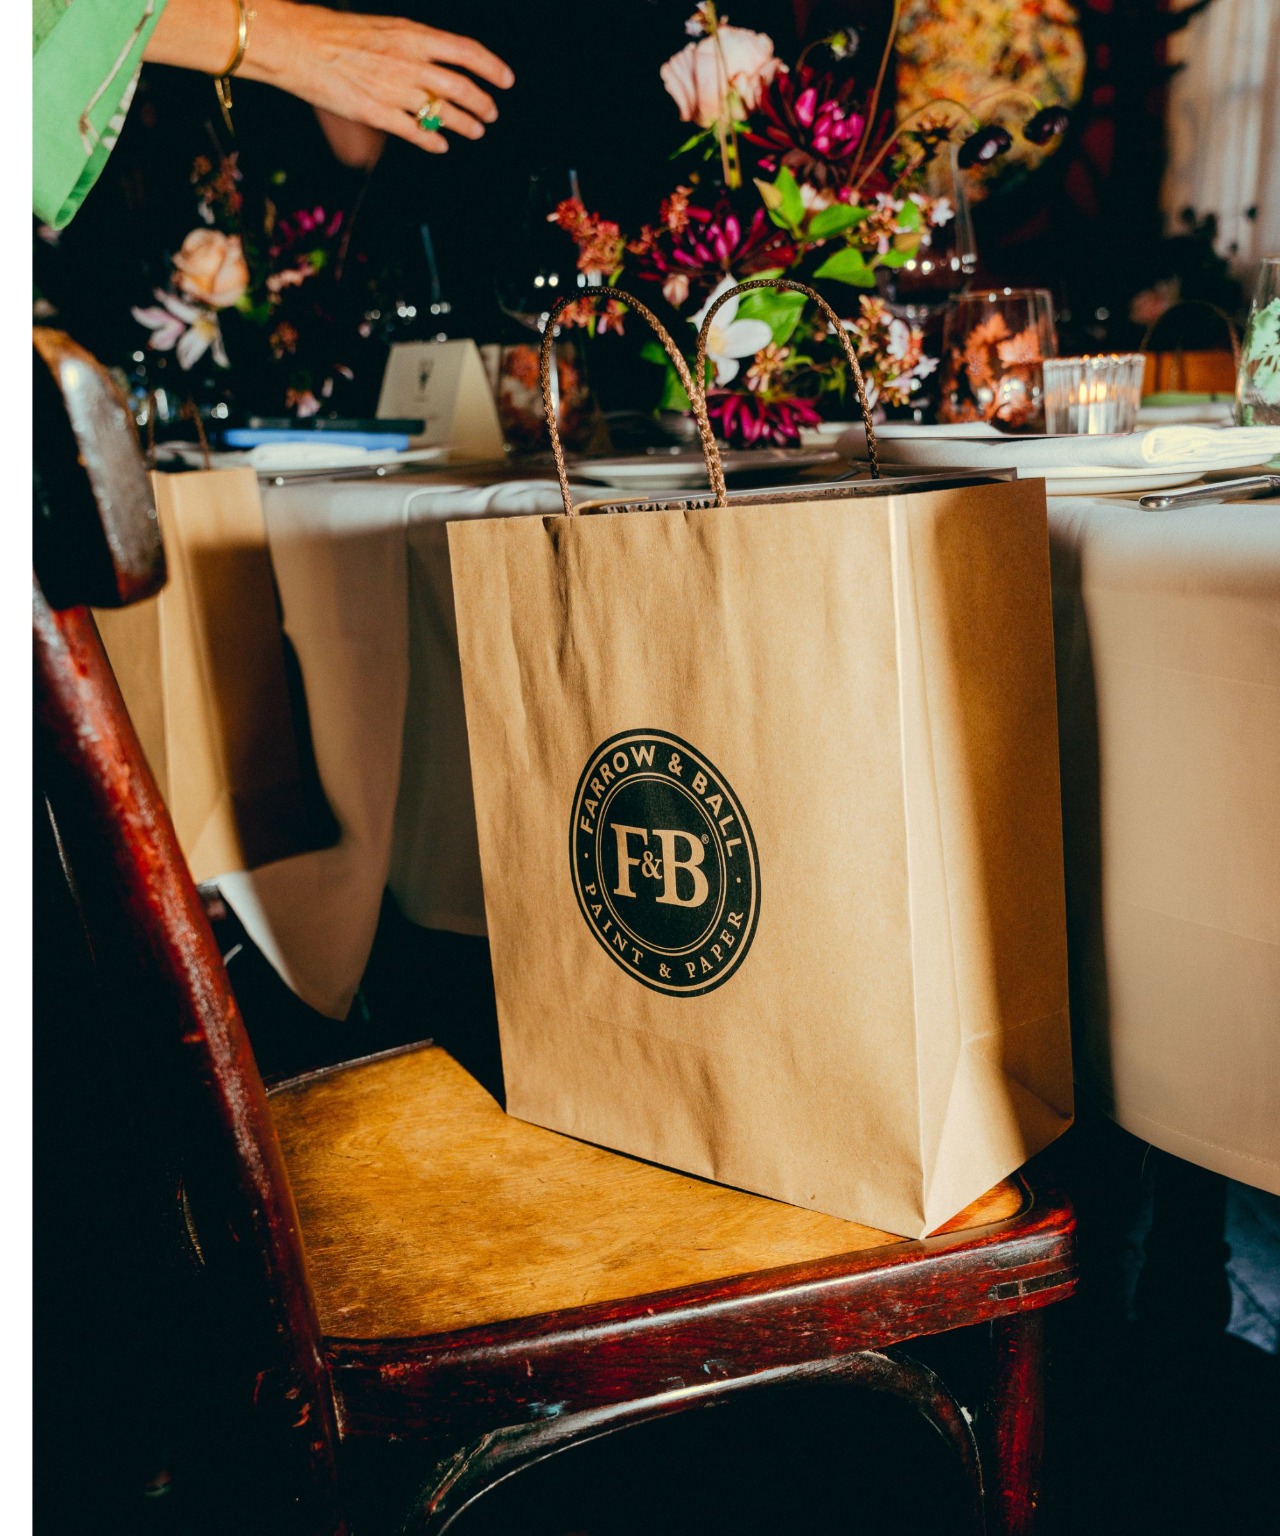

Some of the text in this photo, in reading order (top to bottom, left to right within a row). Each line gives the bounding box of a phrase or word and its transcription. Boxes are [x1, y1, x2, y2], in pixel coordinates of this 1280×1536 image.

[580, 745, 742, 857] FARROW & BALL
[585, 882, 744, 978] PAINT & PAPER
